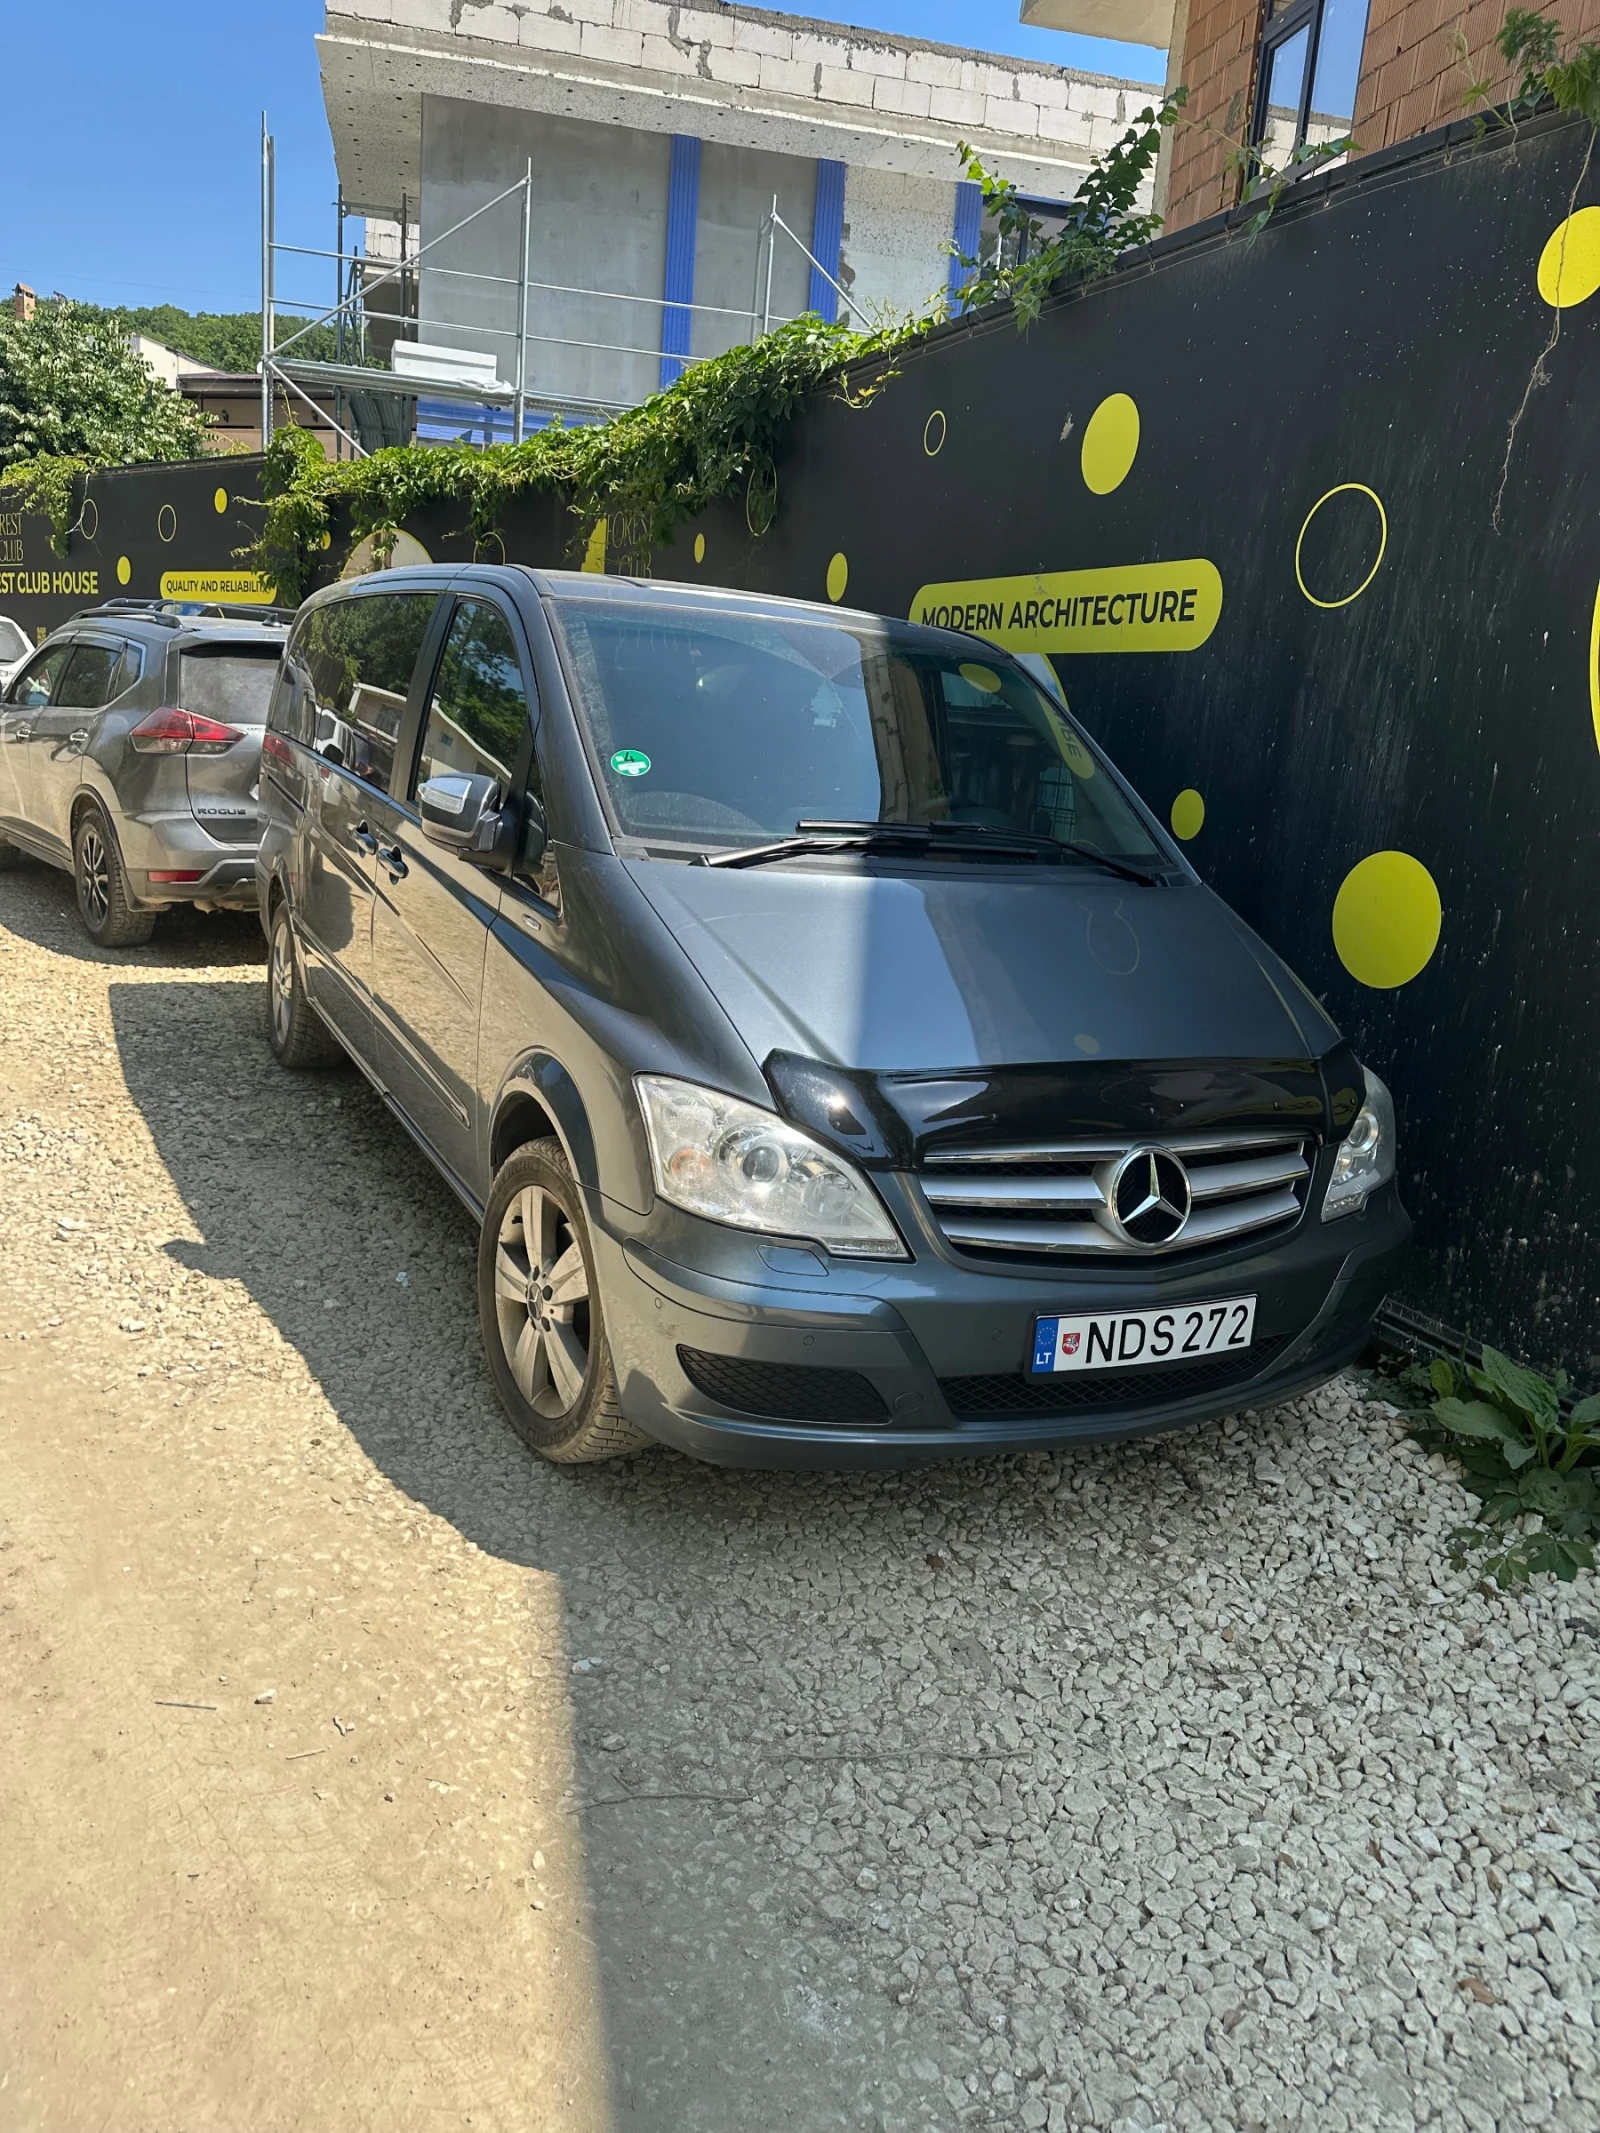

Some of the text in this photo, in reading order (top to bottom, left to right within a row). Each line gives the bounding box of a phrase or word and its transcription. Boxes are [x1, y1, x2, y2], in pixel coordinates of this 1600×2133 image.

[0, 571, 98, 594] ST CLUB HOUSE
[166, 580, 199, 593] QUALITY
[200, 580, 218, 592] AND
[921, 588, 1198, 631] MODERN ARCHITECTURE
[624, 751, 635, 762] 4
[197, 807, 246, 815] ROGUE
[1035, 1352, 1052, 1365] LT
